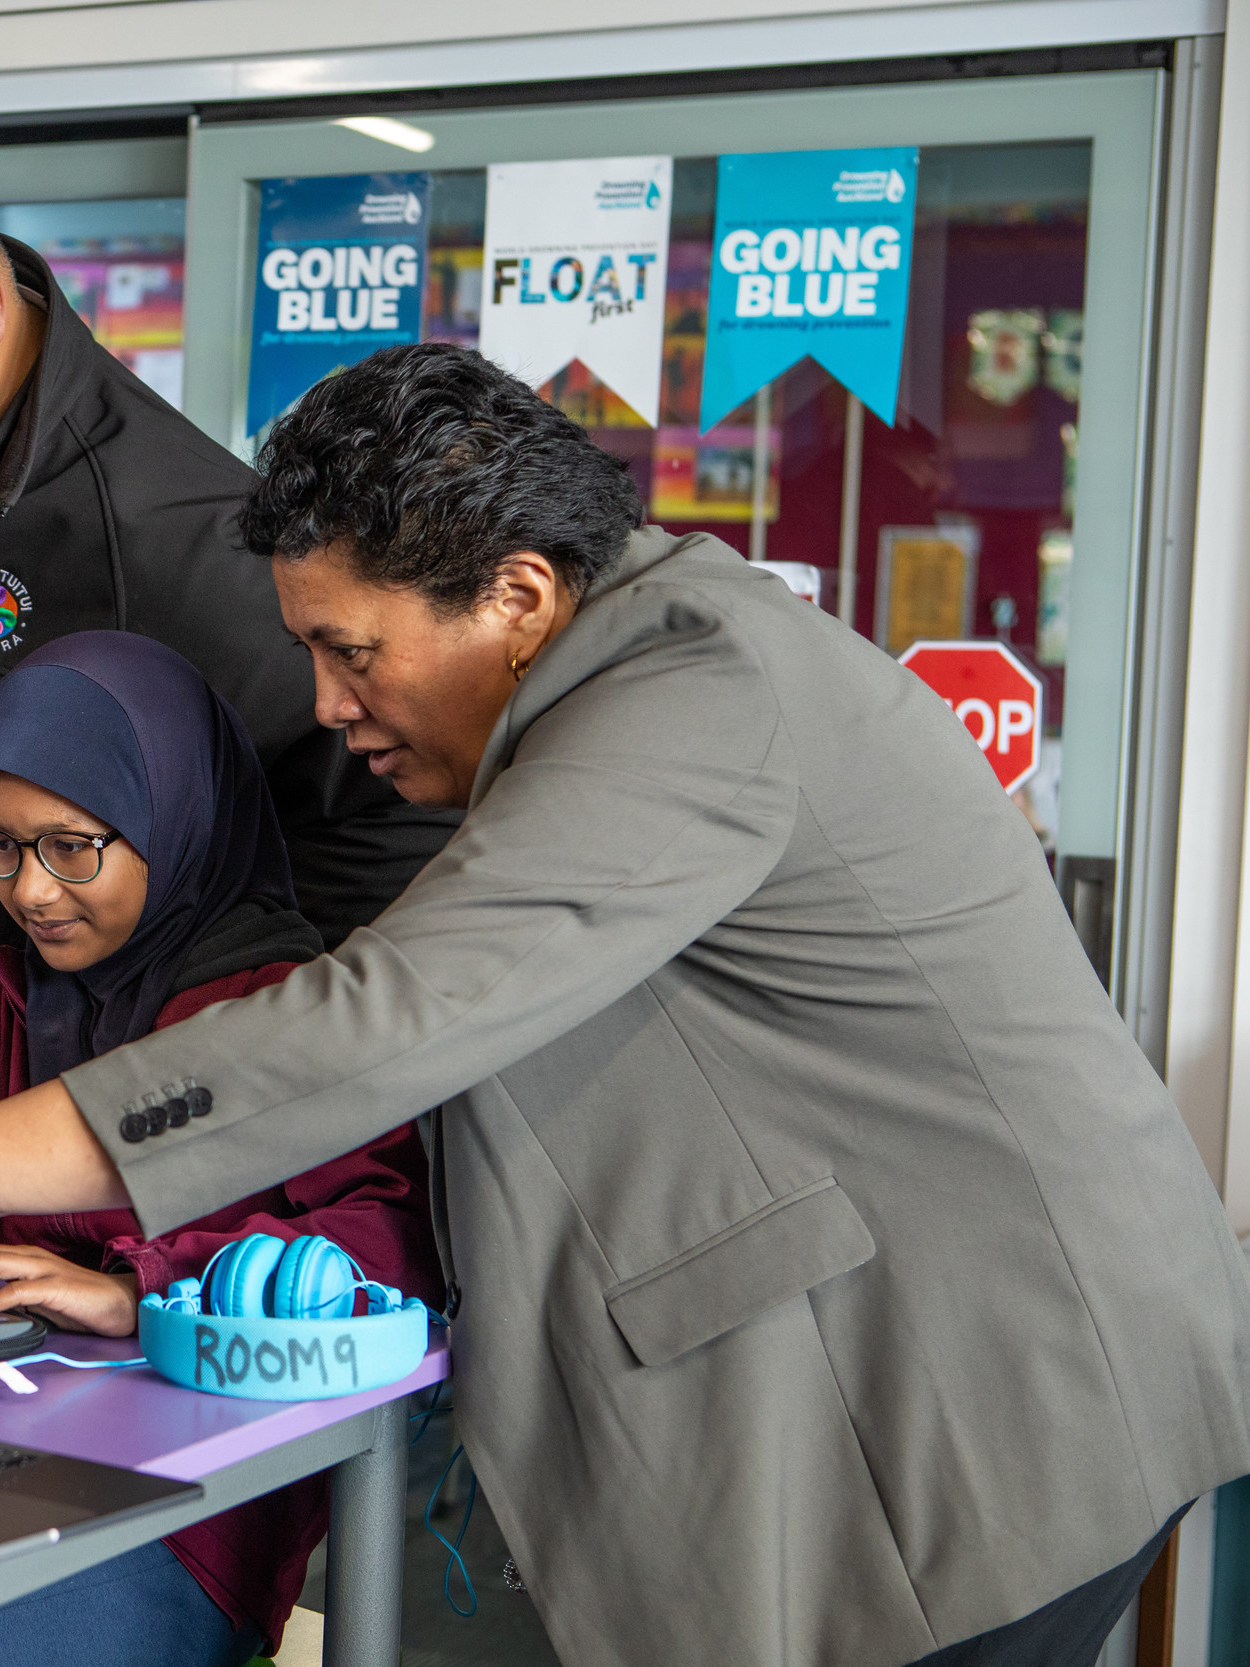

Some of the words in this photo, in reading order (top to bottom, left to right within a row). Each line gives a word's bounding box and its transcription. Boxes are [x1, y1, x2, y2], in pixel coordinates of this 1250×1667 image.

[262, 244, 418, 290] GOING
[720, 225, 901, 274] GOING
[492, 254, 656, 305] FLOAT
[735, 272, 879, 317] BLUE
[277, 288, 400, 331] BLUE
[590, 299, 634, 325] first
[945, 698, 1034, 754] OP
